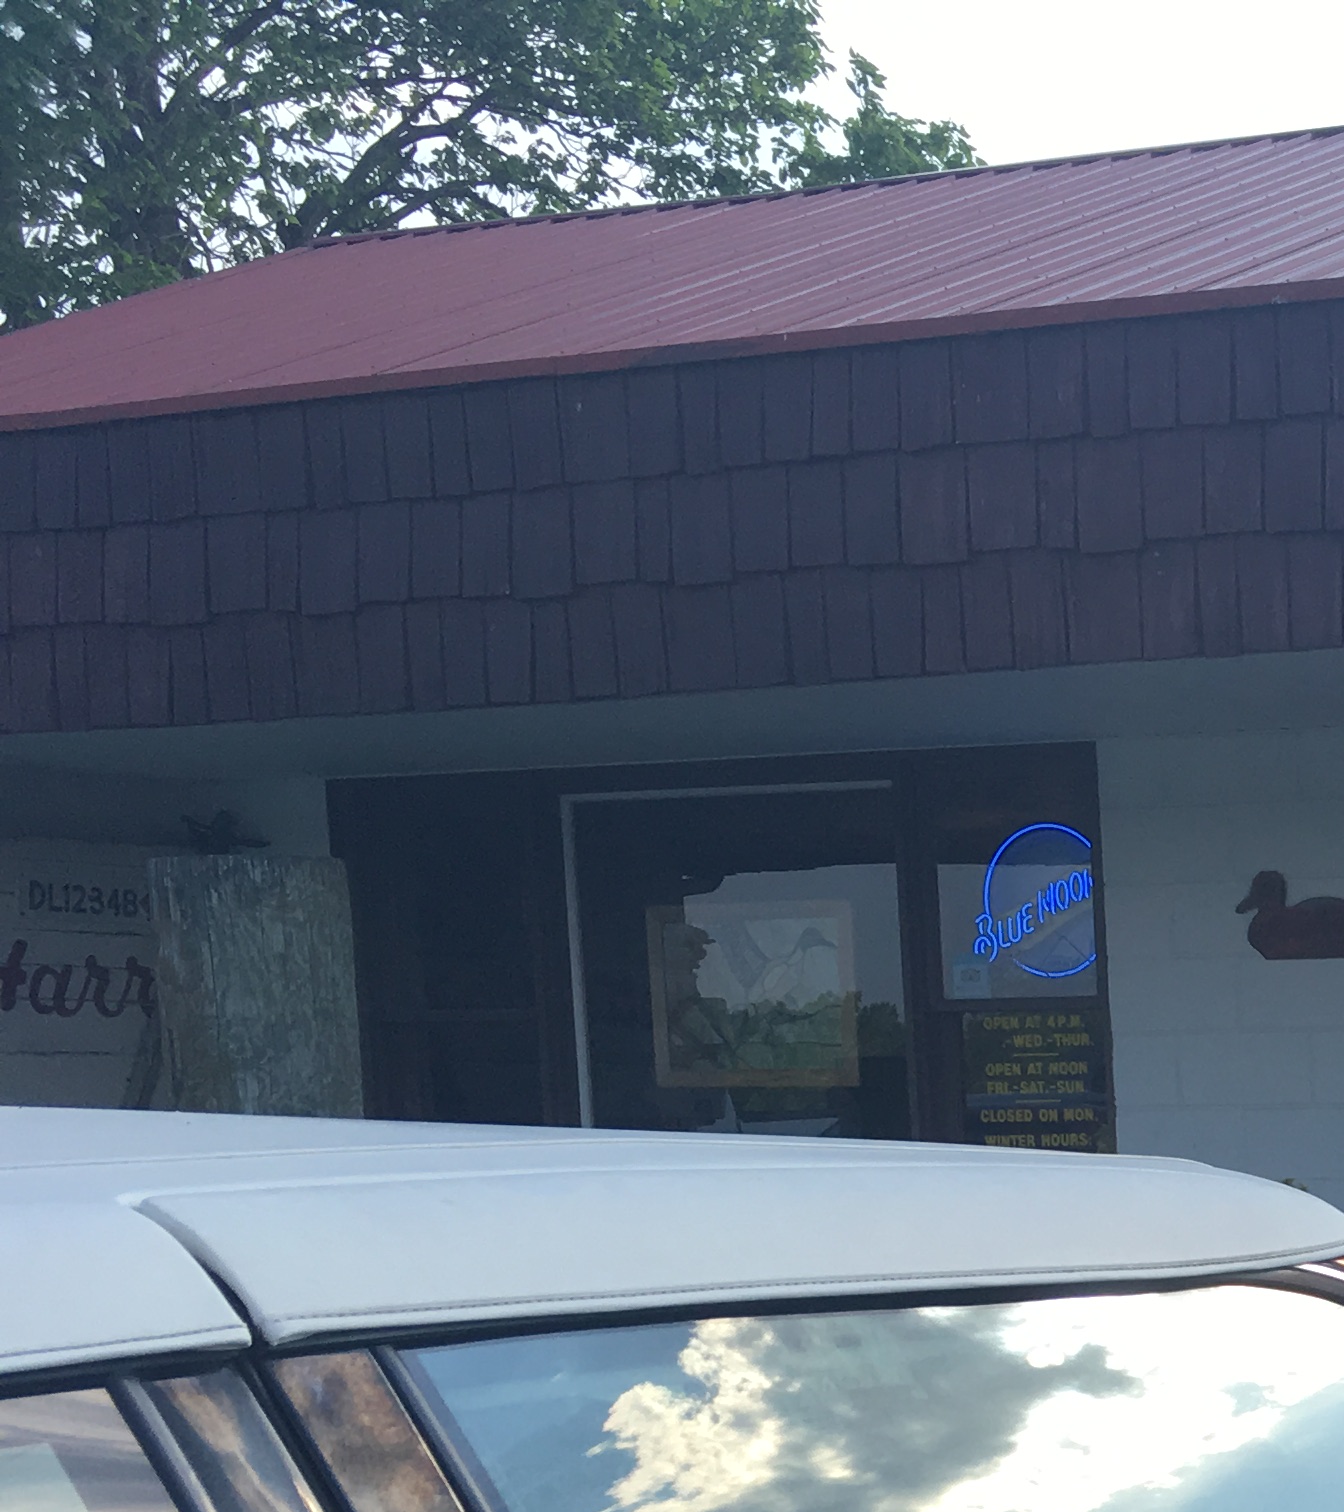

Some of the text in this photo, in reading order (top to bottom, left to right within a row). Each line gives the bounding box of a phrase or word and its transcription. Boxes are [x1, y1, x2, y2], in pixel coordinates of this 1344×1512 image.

[973, 901, 1035, 963] BLUE
[983, 1017, 1019, 1030] OPEN
[1025, 1016, 1042, 1028] AT
[985, 1061, 1088, 1076] OPEN AT NOON
[980, 1109, 1033, 1123] CLOSED
[1039, 1108, 1058, 1122] ON
